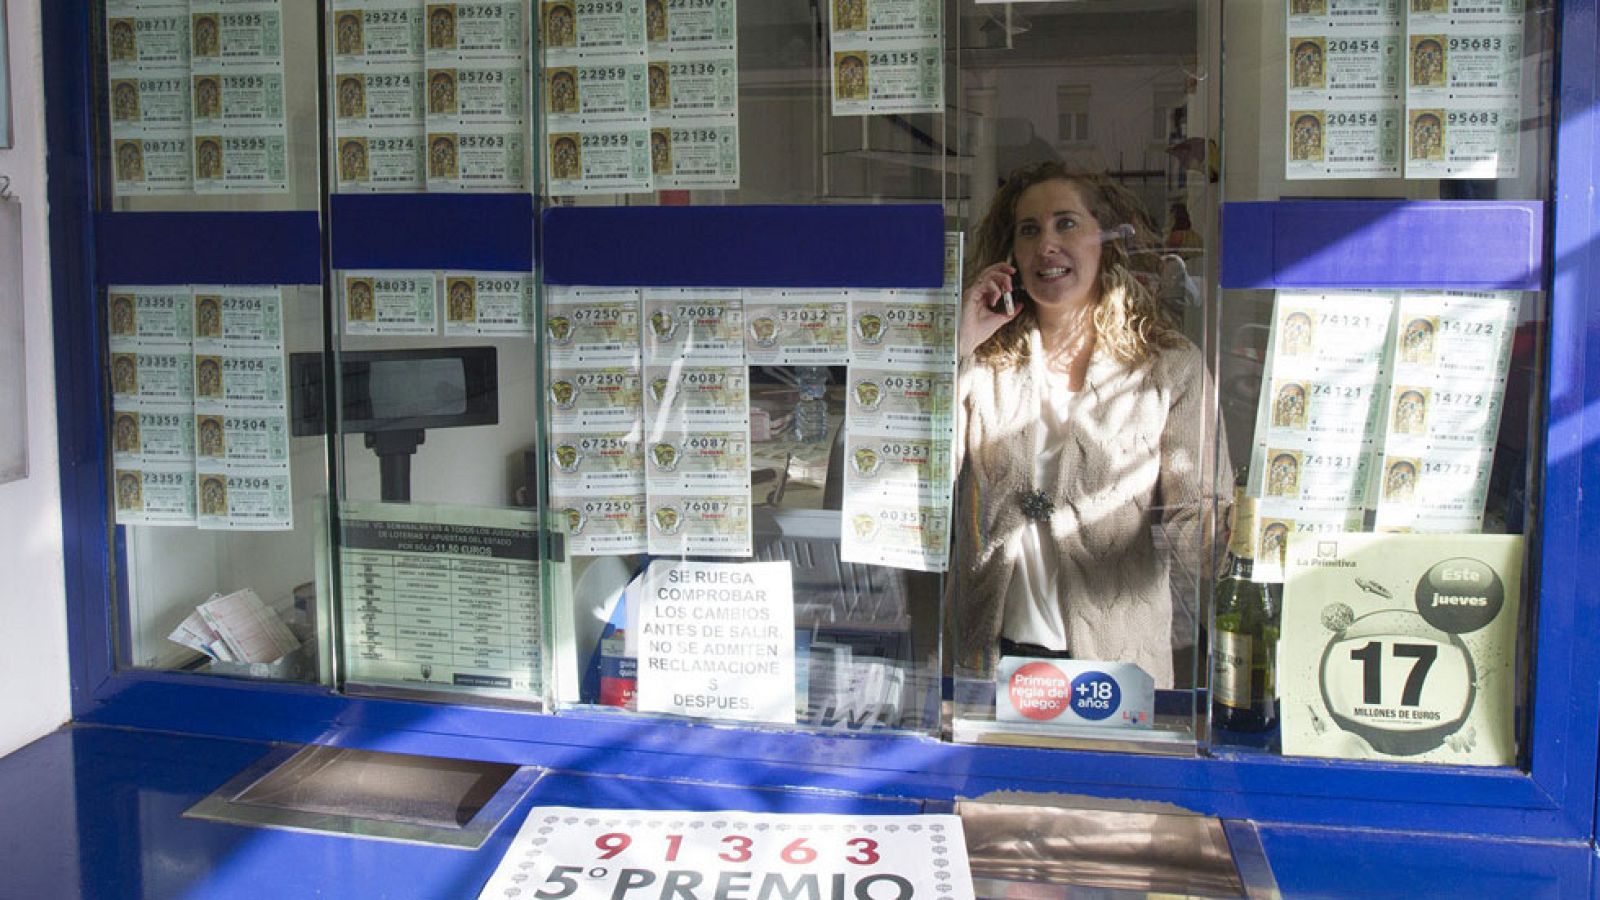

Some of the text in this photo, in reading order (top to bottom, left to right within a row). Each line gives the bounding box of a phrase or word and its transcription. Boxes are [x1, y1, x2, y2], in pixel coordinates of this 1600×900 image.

[458, 6, 502, 18] 85763
[578, 1, 623, 14] 22959
[222, 14, 262, 26] 15595
[365, 12, 408, 24] 29274
[136, 19, 176, 32] 08717
[1328, 40, 1380, 52] 20454
[1450, 38, 1502, 50] 95683
[870, 52, 918, 66] 24155
[580, 68, 626, 80] 22959
[670, 64, 716, 76] 22136
[224, 76, 264, 88] 15595
[366, 76, 410, 87] 29274
[460, 71, 504, 82] 85763
[140, 80, 181, 92] 08717
[1328, 114, 1378, 126] 20454
[1448, 112, 1499, 125] 95683
[460, 136, 504, 147] 85763
[582, 135, 628, 147] 22959
[672, 130, 718, 142] 22136
[144, 141, 186, 152] 08717
[226, 138, 266, 150] 15595
[369, 138, 414, 150] 29274
[375, 280, 416, 292] 48033
[478, 280, 520, 291] 52007
[137, 298, 174, 308] 73359
[222, 299, 262, 310] 47504
[574, 308, 620, 320] 67250
[678, 306, 725, 318] 76087
[780, 310, 828, 322] 32032
[886, 310, 936, 322] 60351
[1320, 314, 1372, 327] 74121
[1443, 320, 1494, 335] 14772
[138, 356, 177, 366] 73359
[224, 358, 264, 370] 47504
[578, 374, 624, 386] 67250
[680, 373, 726, 384] 76087
[884, 376, 933, 389] 60351
[1313, 383, 1362, 398] 74121
[1434, 391, 1483, 407] 14772
[141, 415, 180, 426] 73359
[226, 418, 267, 430] 47504
[582, 438, 628, 450] 67250
[882, 444, 930, 456] 60351
[1305, 454, 1352, 468] 74121
[1424, 462, 1472, 476] 14772
[144, 473, 184, 484] 73359
[228, 478, 270, 490] 47504
[586, 502, 632, 512] 67250
[684, 502, 730, 512] 76087
[880, 510, 928, 522] 60351
[461, 546, 492, 556] EUROS
[1296, 558, 1357, 568] La Primitiva
[668, 569, 754, 585] SE RUEGA
[1442, 568, 1480, 581] Este
[658, 588, 767, 602] COMPROBAR
[1432, 592, 1488, 607] jueves
[655, 606, 771, 621] LOS CAMBIOS
[643, 622, 698, 637] ANTES
[702, 624, 726, 638] DE
[650, 640, 778, 656] NO SE ADMITEN
[648, 657, 780, 675] RECLAMACIONE
[1350, 640, 1438, 707] 17
[708, 677, 718, 692] S
[1015, 674, 1066, 688] Primera
[1011, 686, 1068, 700] regla del
[1075, 681, 1113, 700] +18
[673, 693, 756, 710] DESPUES.
[1019, 699, 1061, 710] juego:
[1078, 698, 1110, 710] años
[1353, 707, 1441, 721] MILLONES DE EUROS
[594, 832, 882, 866] 91363
[611, 867, 916, 900] PREMIO
